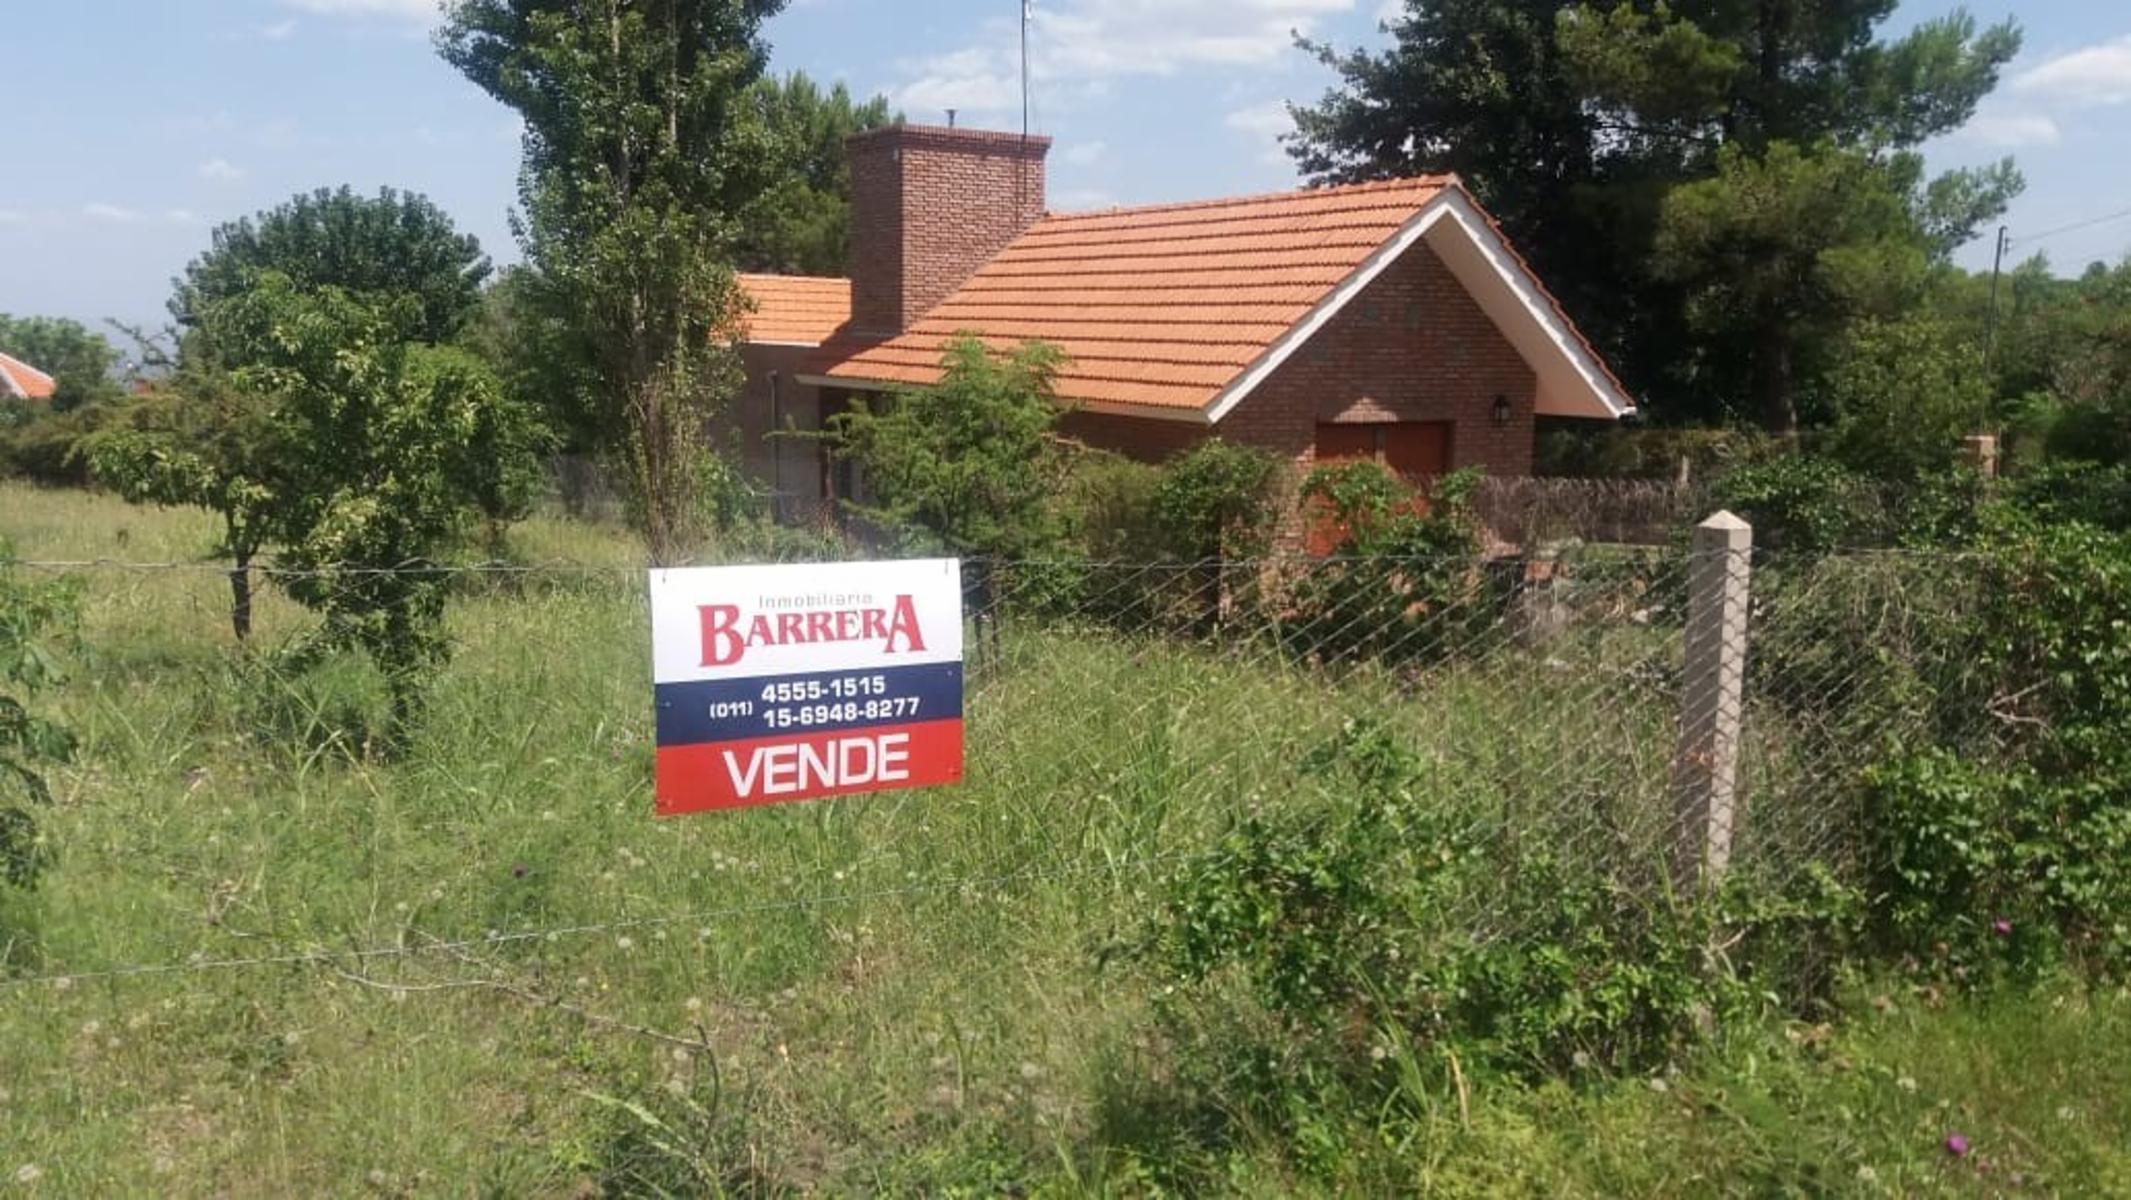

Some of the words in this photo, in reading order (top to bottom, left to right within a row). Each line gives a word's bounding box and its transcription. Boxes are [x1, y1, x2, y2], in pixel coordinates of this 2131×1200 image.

[759, 593, 873, 609] Inmobiliaria
[697, 594, 927, 667] BARRERA
[761, 675, 885, 703] 4555-1515
[710, 701, 753, 718] (011)
[763, 697, 920, 727] 15-6948-8277
[722, 733, 909, 797] VENDE
